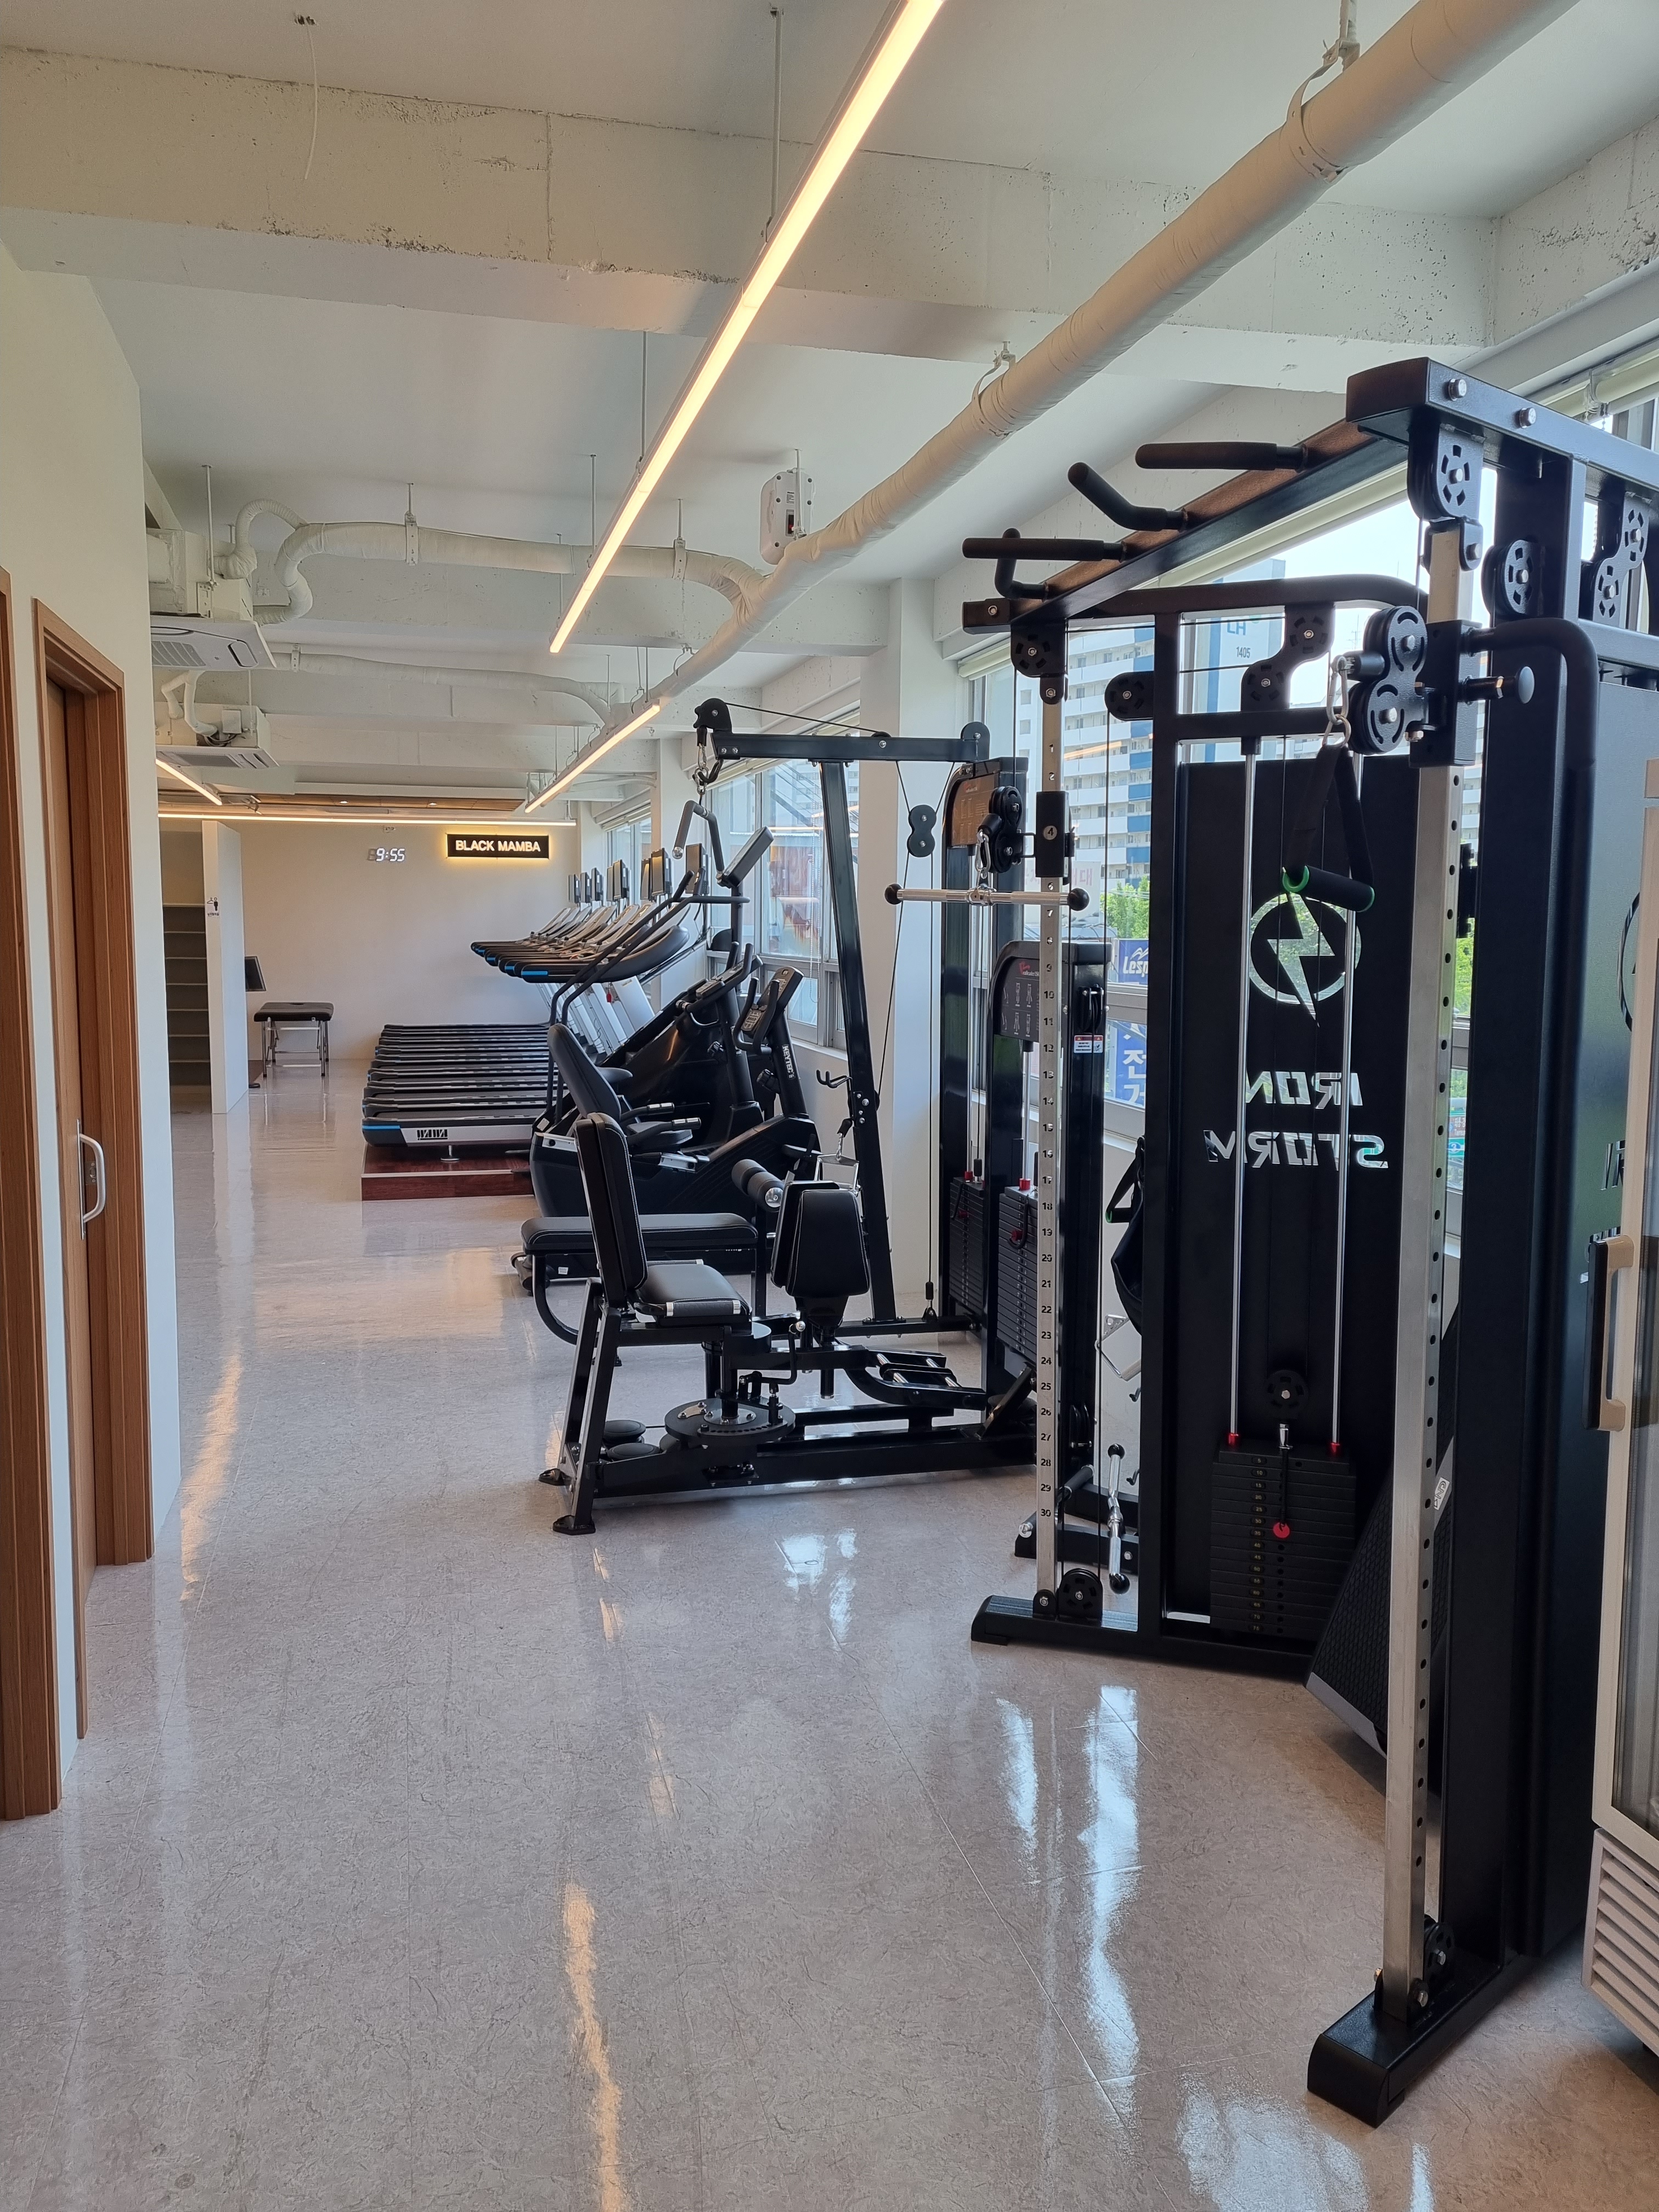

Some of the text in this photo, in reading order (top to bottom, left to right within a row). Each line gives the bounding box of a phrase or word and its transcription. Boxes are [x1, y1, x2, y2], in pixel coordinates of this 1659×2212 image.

[1236, 646, 1251, 658] 1405
[1049, 744, 1054, 753] 1
[1048, 772, 1055, 781] 2
[1047, 827, 1054, 836] 4
[455, 840, 541, 853] BLACK MAMBA
[376, 848, 405, 862] 9:55
[1047, 882, 1054, 891] 6
[1047, 910, 1053, 918] 7
[1046, 963, 1052, 972] 9
[1044, 991, 1054, 999] 10
[1043, 1044, 1054, 1052] 12
[782, 1045, 793, 1073] KEYTEC
[1043, 1071, 1054, 1079] 13
[1043, 1097, 1053, 1105] 14
[1043, 1124, 1053, 1132] 15
[1043, 1150, 1053, 1158] 16
[1042, 1176, 1052, 1184] 17
[1042, 1202, 1052, 1210] 18
[1042, 1228, 1052, 1236] 19
[1041, 1254, 1052, 1262] 20
[1041, 1279, 1051, 1288] 21
[1041, 1306, 1052, 1314] 22
[1041, 1331, 1052, 1339] 23
[1041, 1357, 1052, 1365] 24
[1041, 1383, 1051, 1391] 25
[1041, 1408, 1052, 1417] 26
[1041, 1433, 1051, 1442] 27
[1040, 1459, 1051, 1467] 28
[1040, 1484, 1051, 1492] 29
[1040, 1509, 1051, 1517] 30
